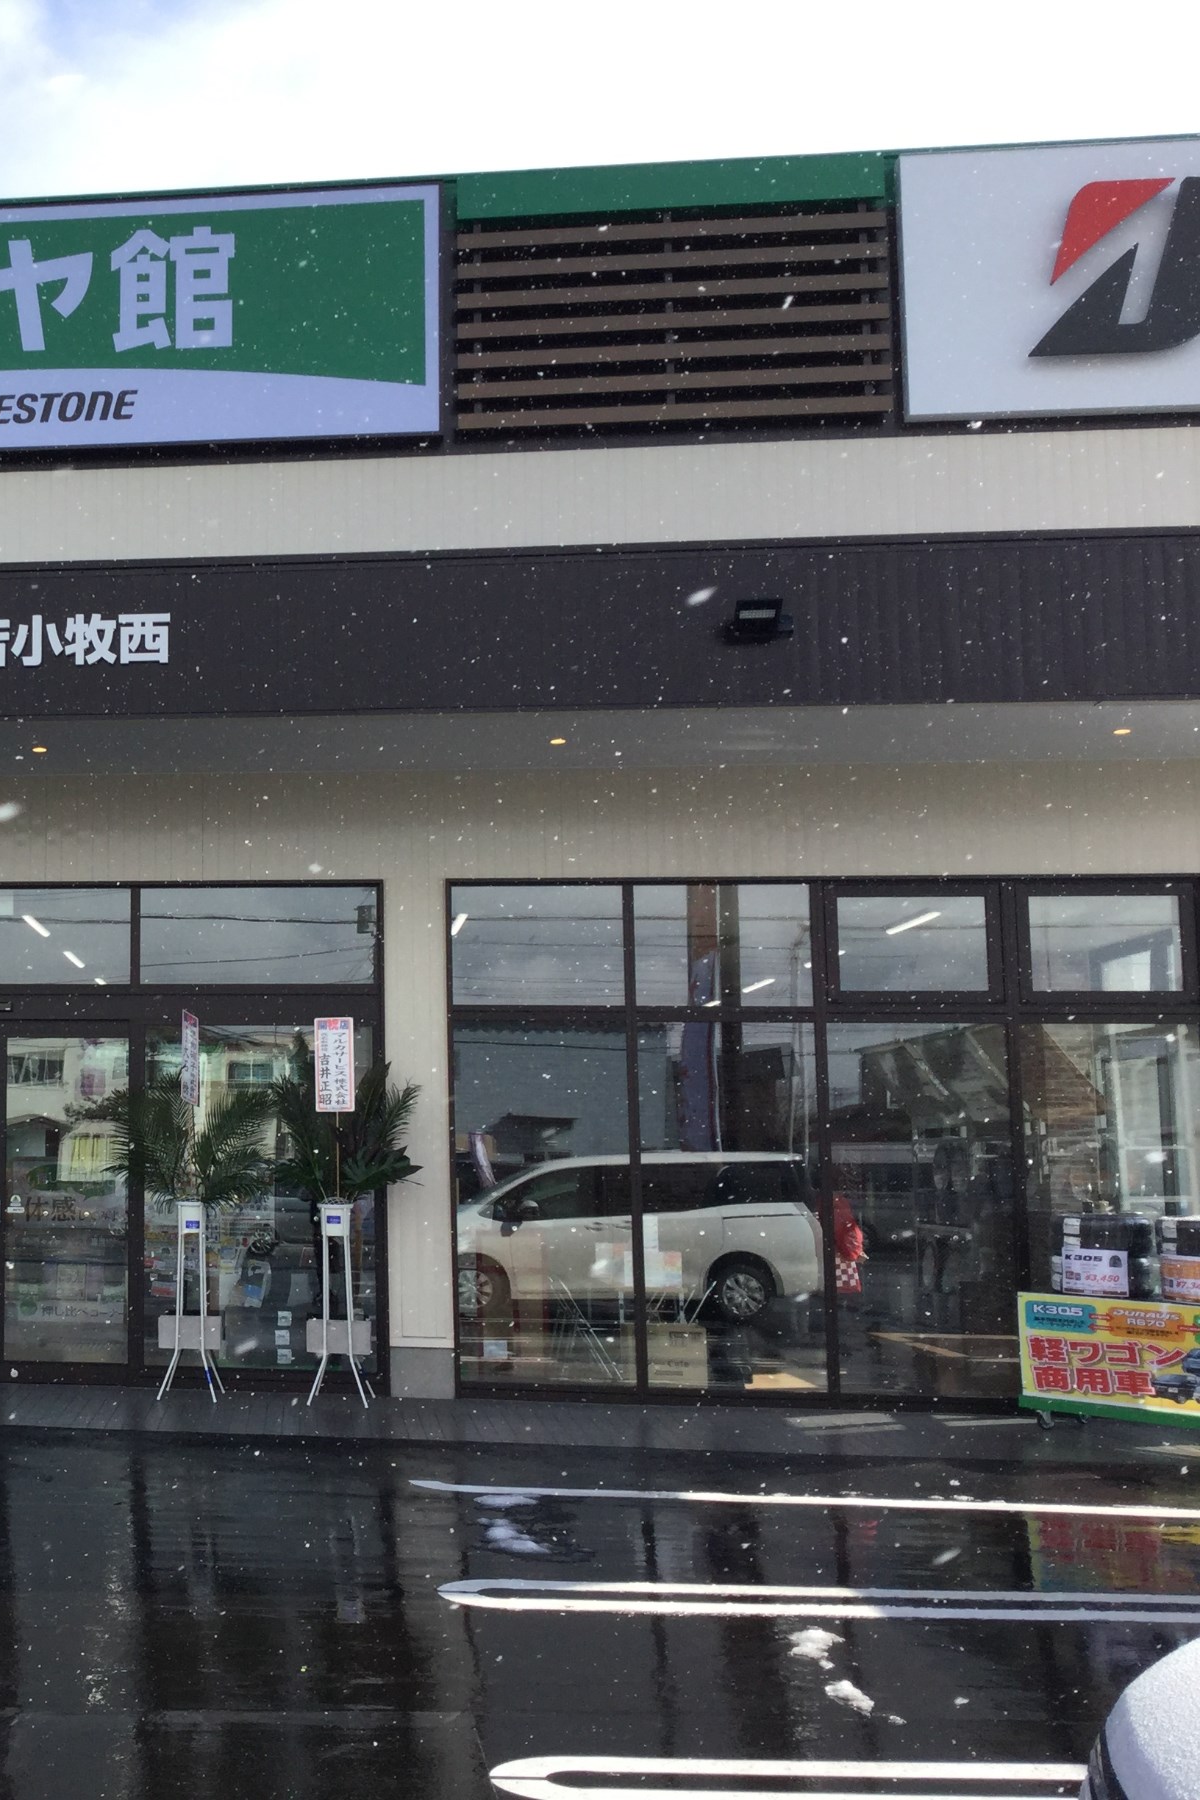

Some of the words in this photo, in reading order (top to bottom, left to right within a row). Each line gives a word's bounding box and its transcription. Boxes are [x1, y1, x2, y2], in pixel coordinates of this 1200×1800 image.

[1064, 1253, 1103, 1261] K305
[1084, 1273, 1120, 1283] ¥3,450
[1033, 1304, 1084, 1317] K305
[1028, 1336, 1187, 1367] 軽ワゴン
[1032, 1364, 1156, 1397] 商用車
